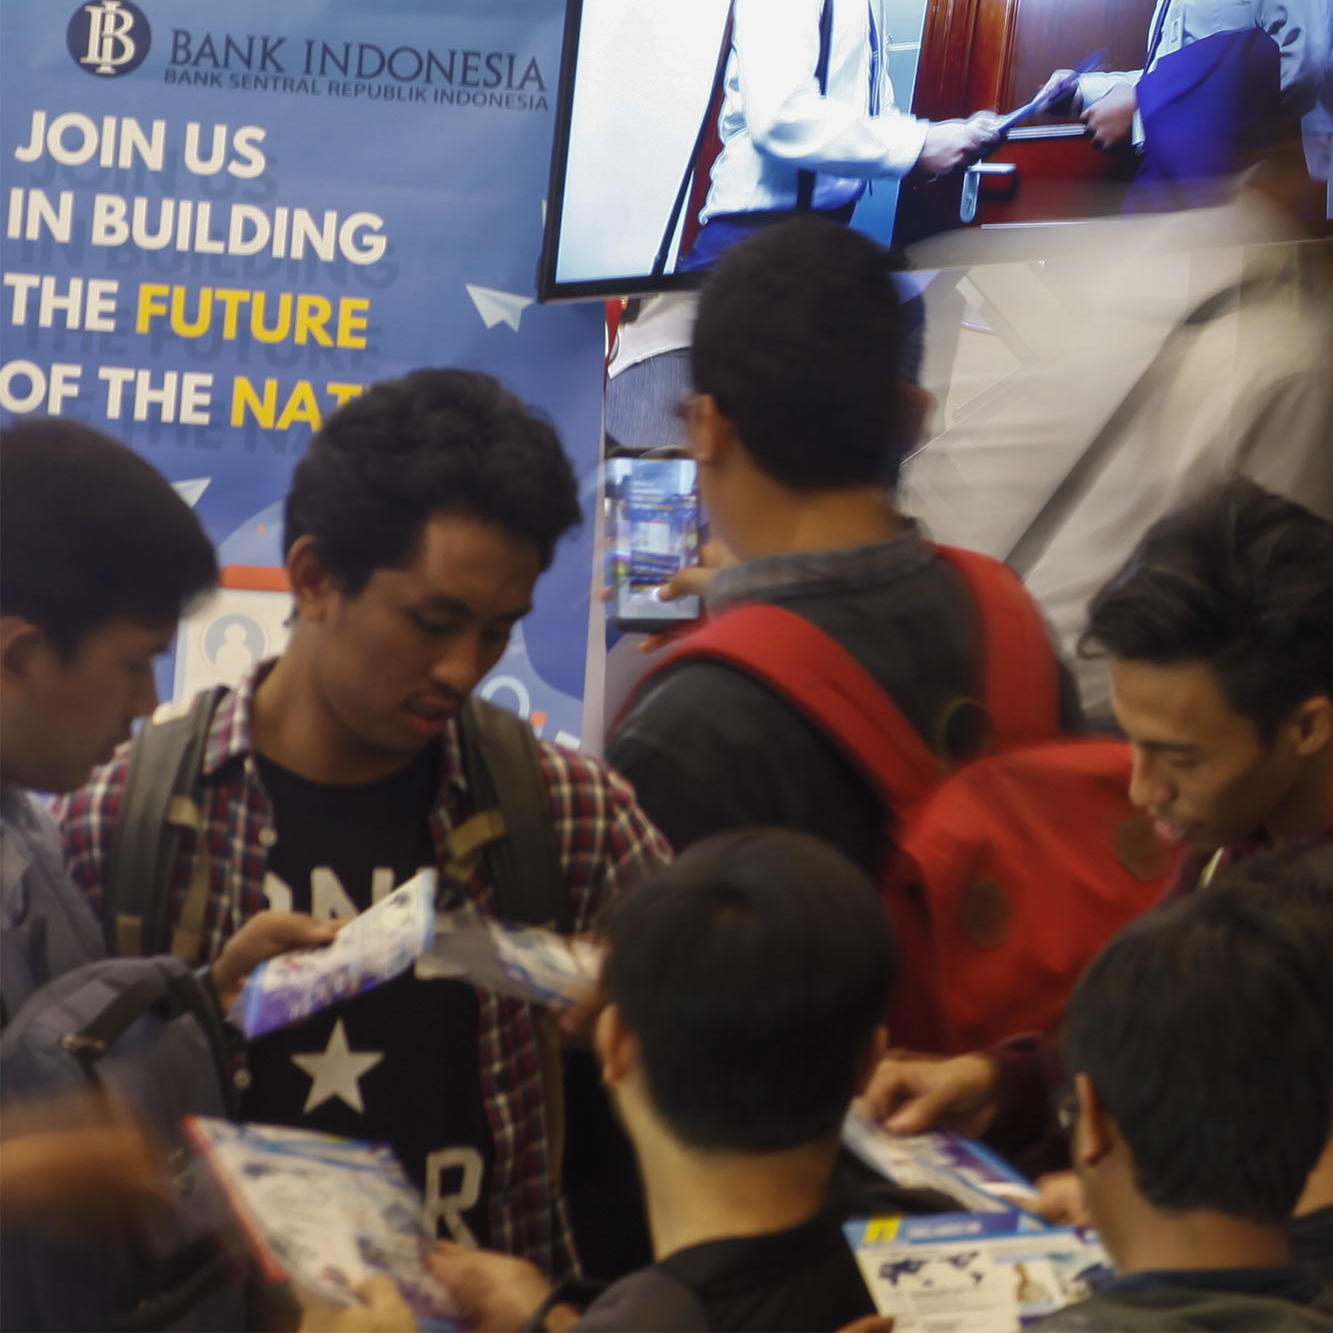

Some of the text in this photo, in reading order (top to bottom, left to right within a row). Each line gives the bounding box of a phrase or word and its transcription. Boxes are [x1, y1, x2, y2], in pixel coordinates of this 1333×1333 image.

[163, 67, 549, 112] BANK SENTRAL REPUBLIK INDONESIA
[169, 28, 549, 92] BANK INDONESIA
[14, 110, 267, 179] JOIN US
[7, 187, 388, 265] IN BUILDING
[2, 272, 370, 349] THE FUTURE
[0, 359, 372, 434] OF THE NAT
